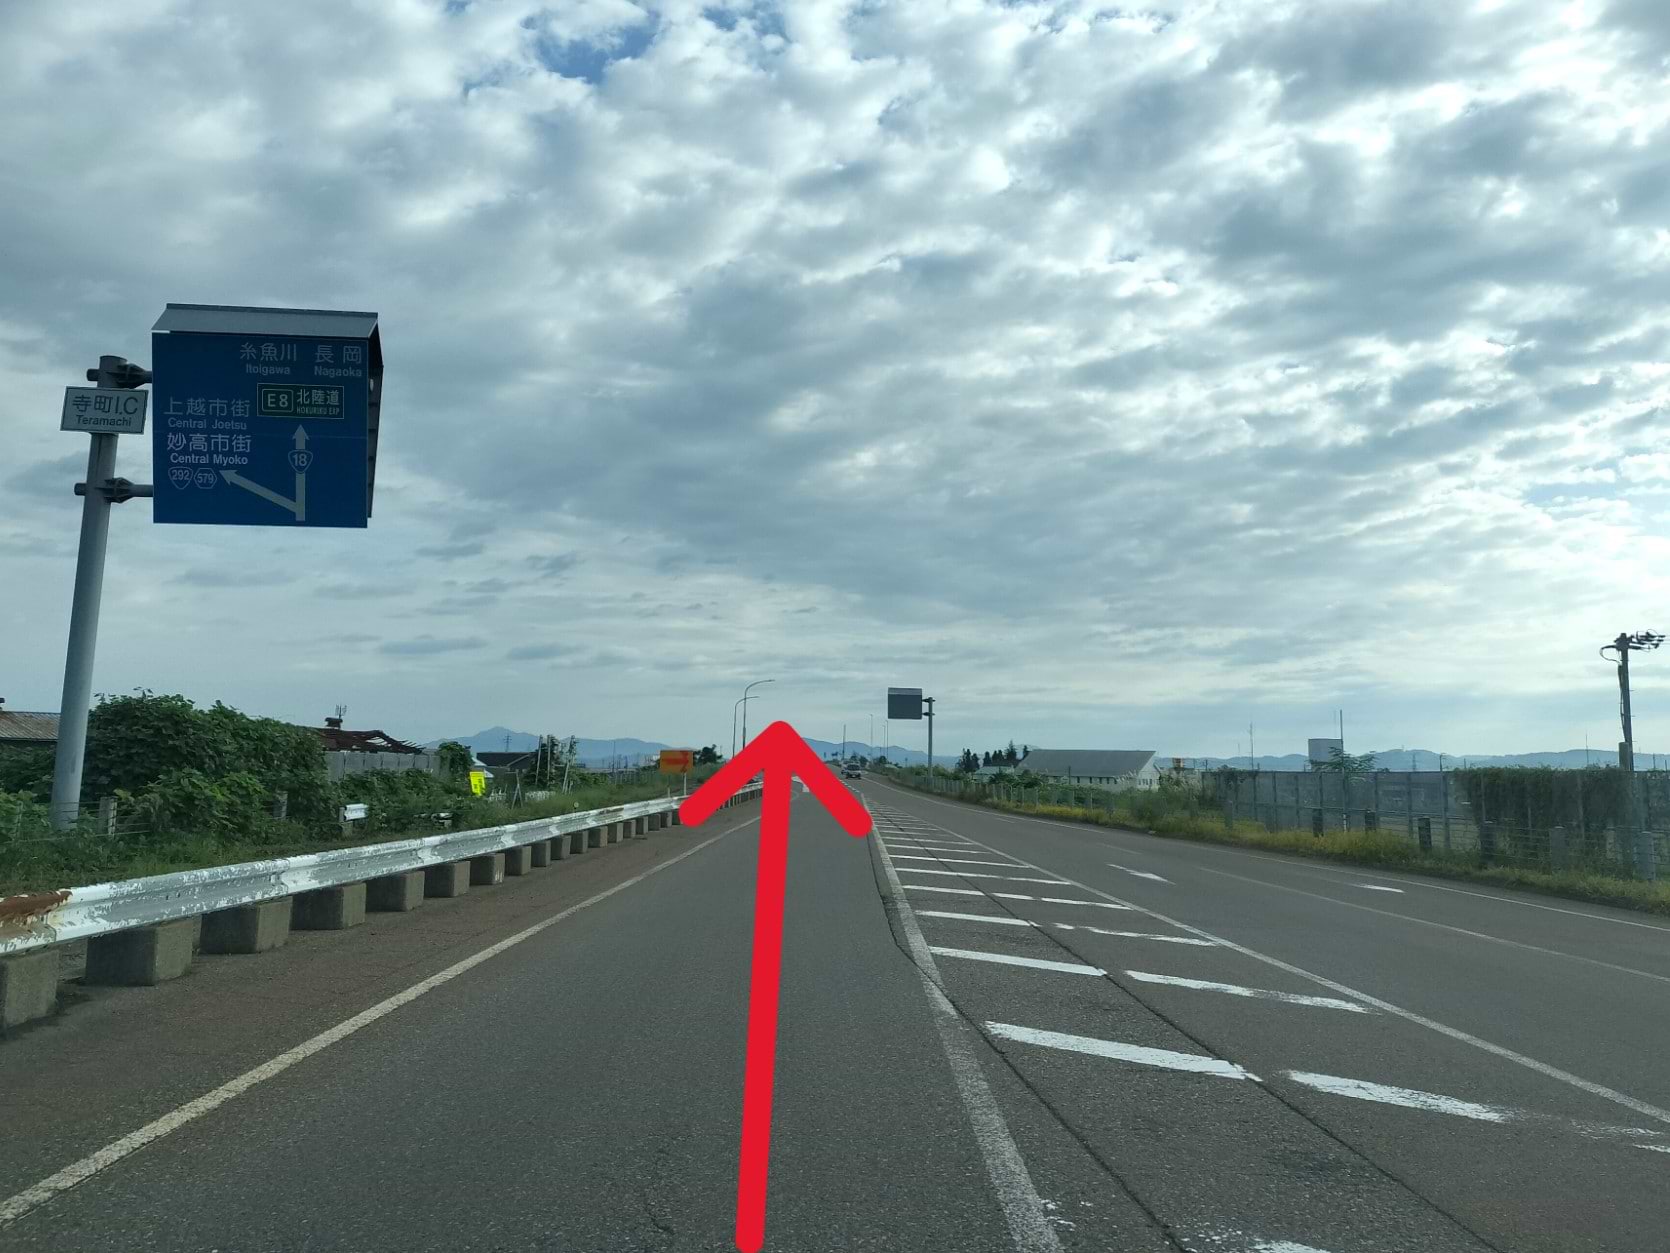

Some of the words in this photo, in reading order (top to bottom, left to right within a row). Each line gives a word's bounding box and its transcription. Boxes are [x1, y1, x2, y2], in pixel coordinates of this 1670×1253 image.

[240, 342, 297, 361] 糸魚川
[315, 345, 362, 364] 長岡
[246, 363, 291, 375] Itoigawa
[314, 366, 362, 378] Nagaoka
[267, 393, 289, 408] E8
[296, 389, 340, 405] 北陸道
[163, 397, 250, 417] 上越市街
[76, 415, 132, 427] Teramachi
[168, 417, 207, 429] Central
[211, 419, 247, 430] Joetsu
[167, 432, 252, 453] 妙高市街
[170, 453, 209, 464] Central
[213, 454, 248, 466] Myoko
[292, 453, 308, 466] 18
[171, 469, 190, 481] 292
[197, 473, 214, 484] 579
